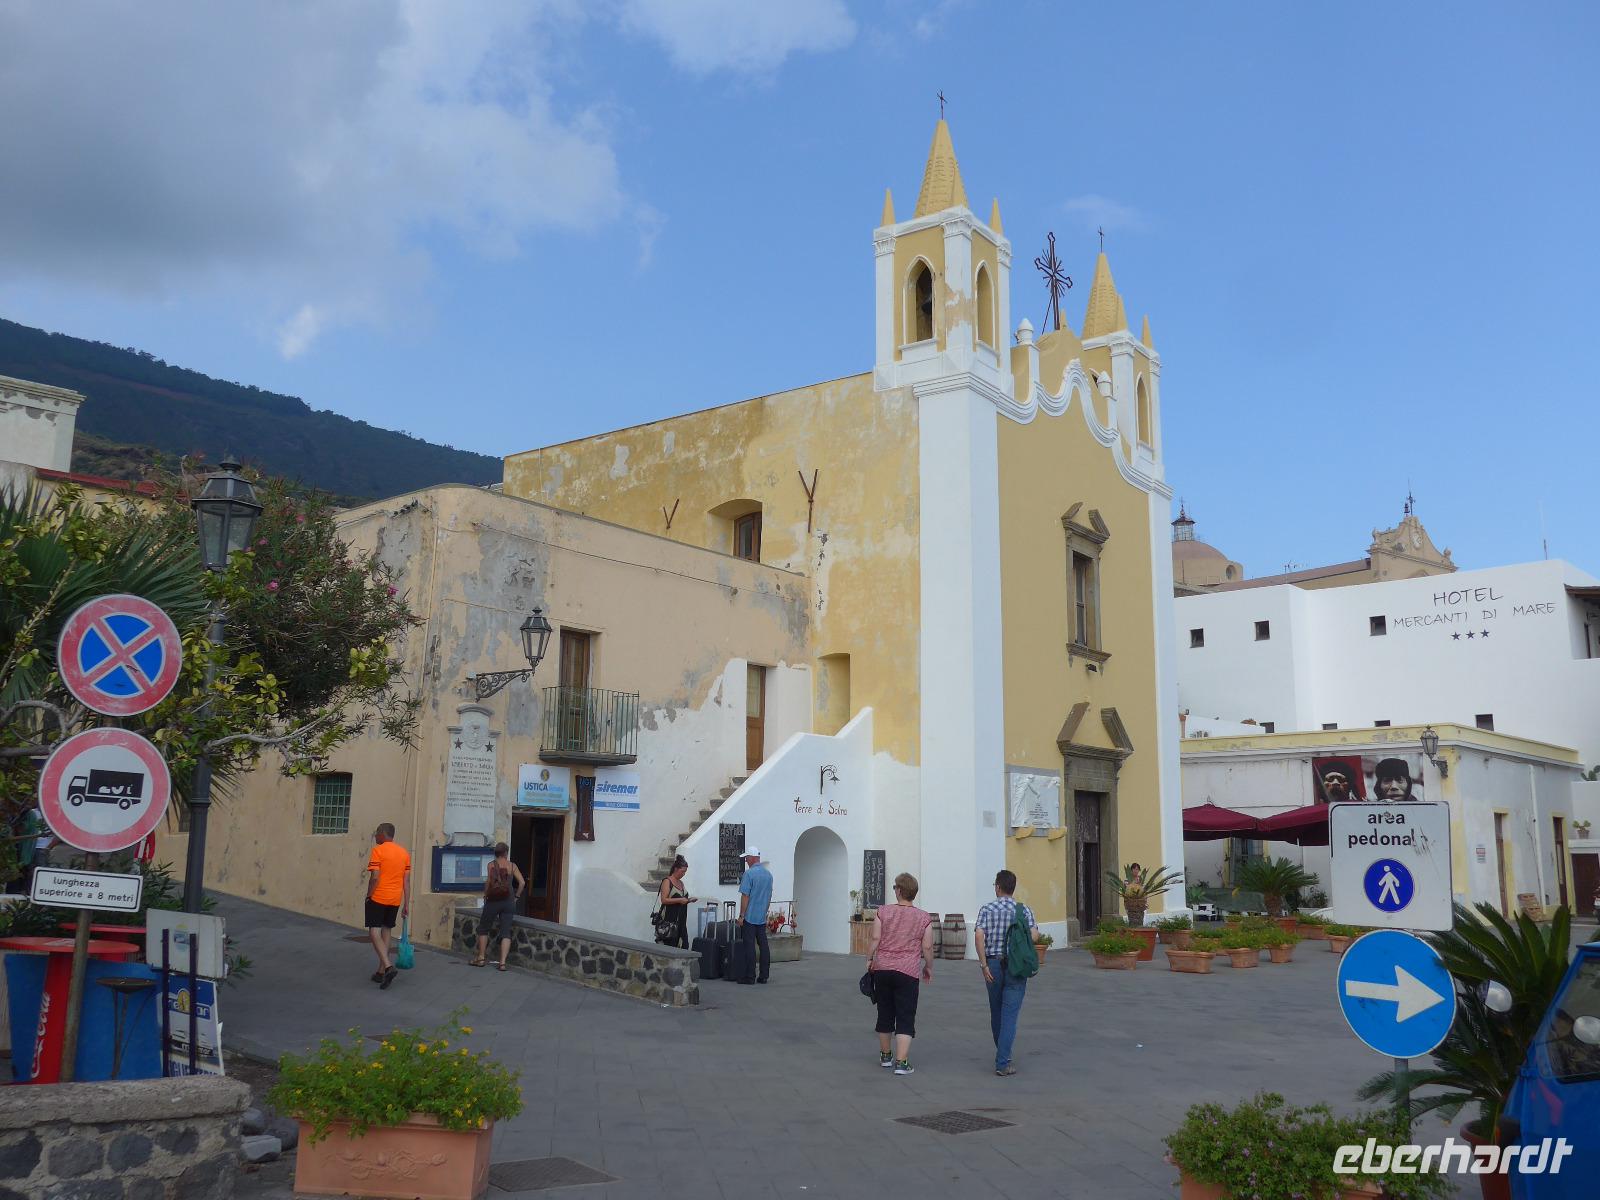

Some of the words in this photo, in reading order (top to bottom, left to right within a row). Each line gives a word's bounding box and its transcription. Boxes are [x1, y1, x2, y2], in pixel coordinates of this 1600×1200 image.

[1433, 587, 1504, 606] HOTEL
[1393, 611, 1468, 628] MERCANTI
[1482, 609, 1497, 620] DI
[1512, 602, 1557, 616] MARE
[524, 782, 548, 792] USTICA
[1367, 811, 1405, 824] area
[53, 877, 100, 887] lunghezza
[39, 887, 83, 897] superiore
[97, 892, 104, 900] 8
[107, 893, 134, 903] metri
